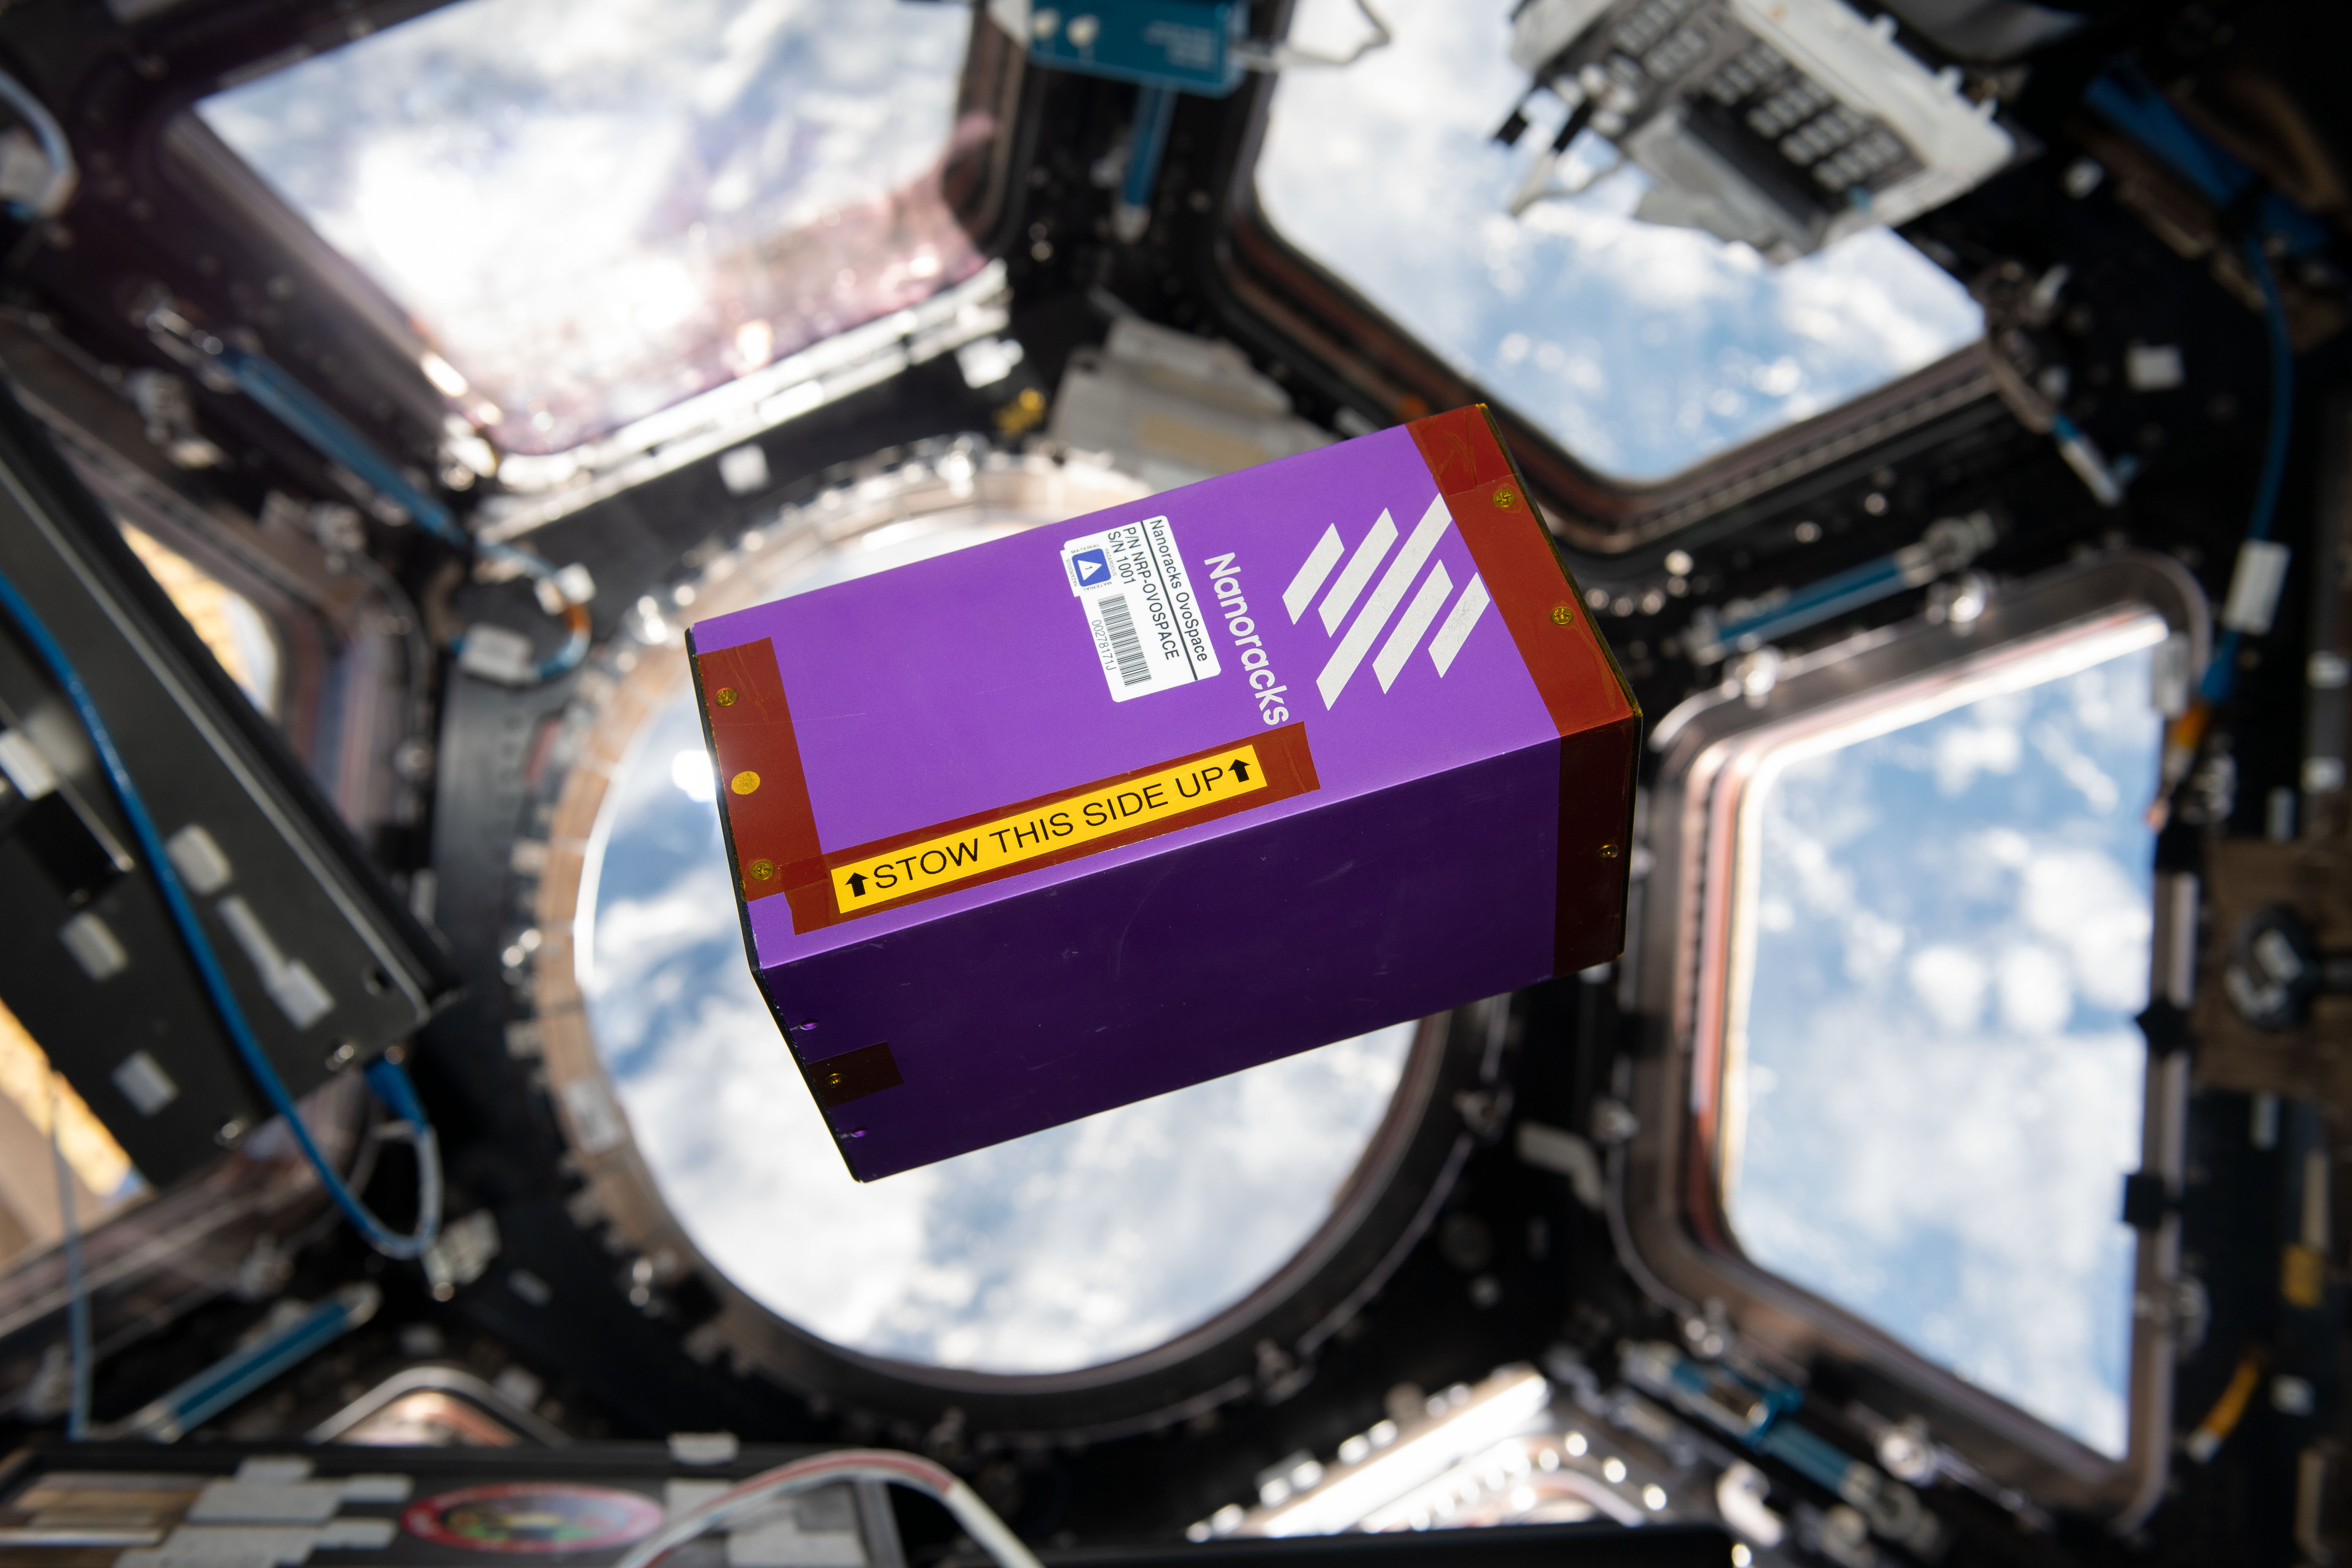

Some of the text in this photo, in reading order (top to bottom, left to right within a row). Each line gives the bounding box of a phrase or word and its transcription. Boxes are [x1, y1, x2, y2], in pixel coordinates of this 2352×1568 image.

[1066, 559, 1078, 587] HAZARDOUS
[1071, 544, 1101, 553] MATERIAL
[1105, 548, 1117, 576] HAZARDOUS
[1108, 531, 1136, 584] S/N 1001
[1082, 581, 1112, 591] MATERIAL
[1123, 527, 1179, 660] P/N NRP-OVOSPACE
[1150, 520, 1207, 661] Nanoracks OvoSpace
[1092, 620, 1117, 670] 00278171J
[1204, 552, 1289, 725] Nanoracks
[874, 767, 1223, 889] STOW THIS SIDE UP
